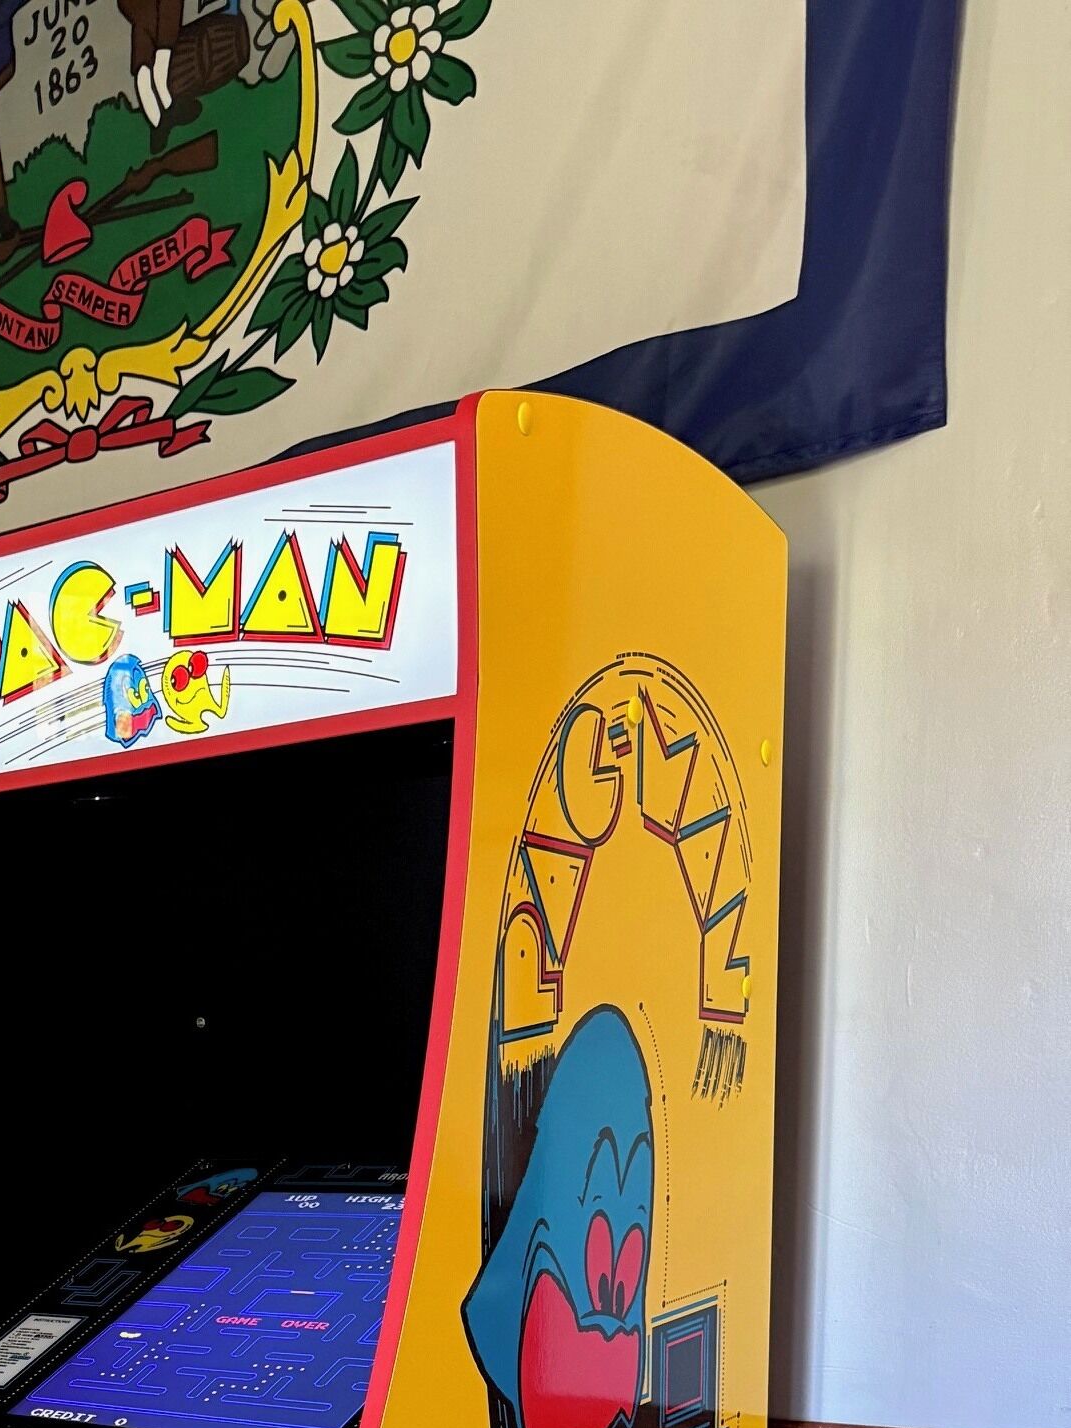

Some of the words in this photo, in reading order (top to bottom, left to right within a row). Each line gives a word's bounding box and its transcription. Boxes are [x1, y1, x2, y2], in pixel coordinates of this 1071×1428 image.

[24, 0, 96, 46] JU
[51, 15, 89, 60] 20
[34, 45, 99, 115] 1863
[52, 279, 130, 325] SEMPER
[118, 229, 189, 287] LIBERI
[284, 1194, 318, 1202] 1UP
[345, 1195, 392, 1203] HIGH
[298, 1201, 320, 1209] 00
[216, 1316, 263, 1327] GAME
[280, 1320, 330, 1331] OVER
[30, 1408, 97, 1423] CREDIT
[113, 1417, 128, 1427] 0
